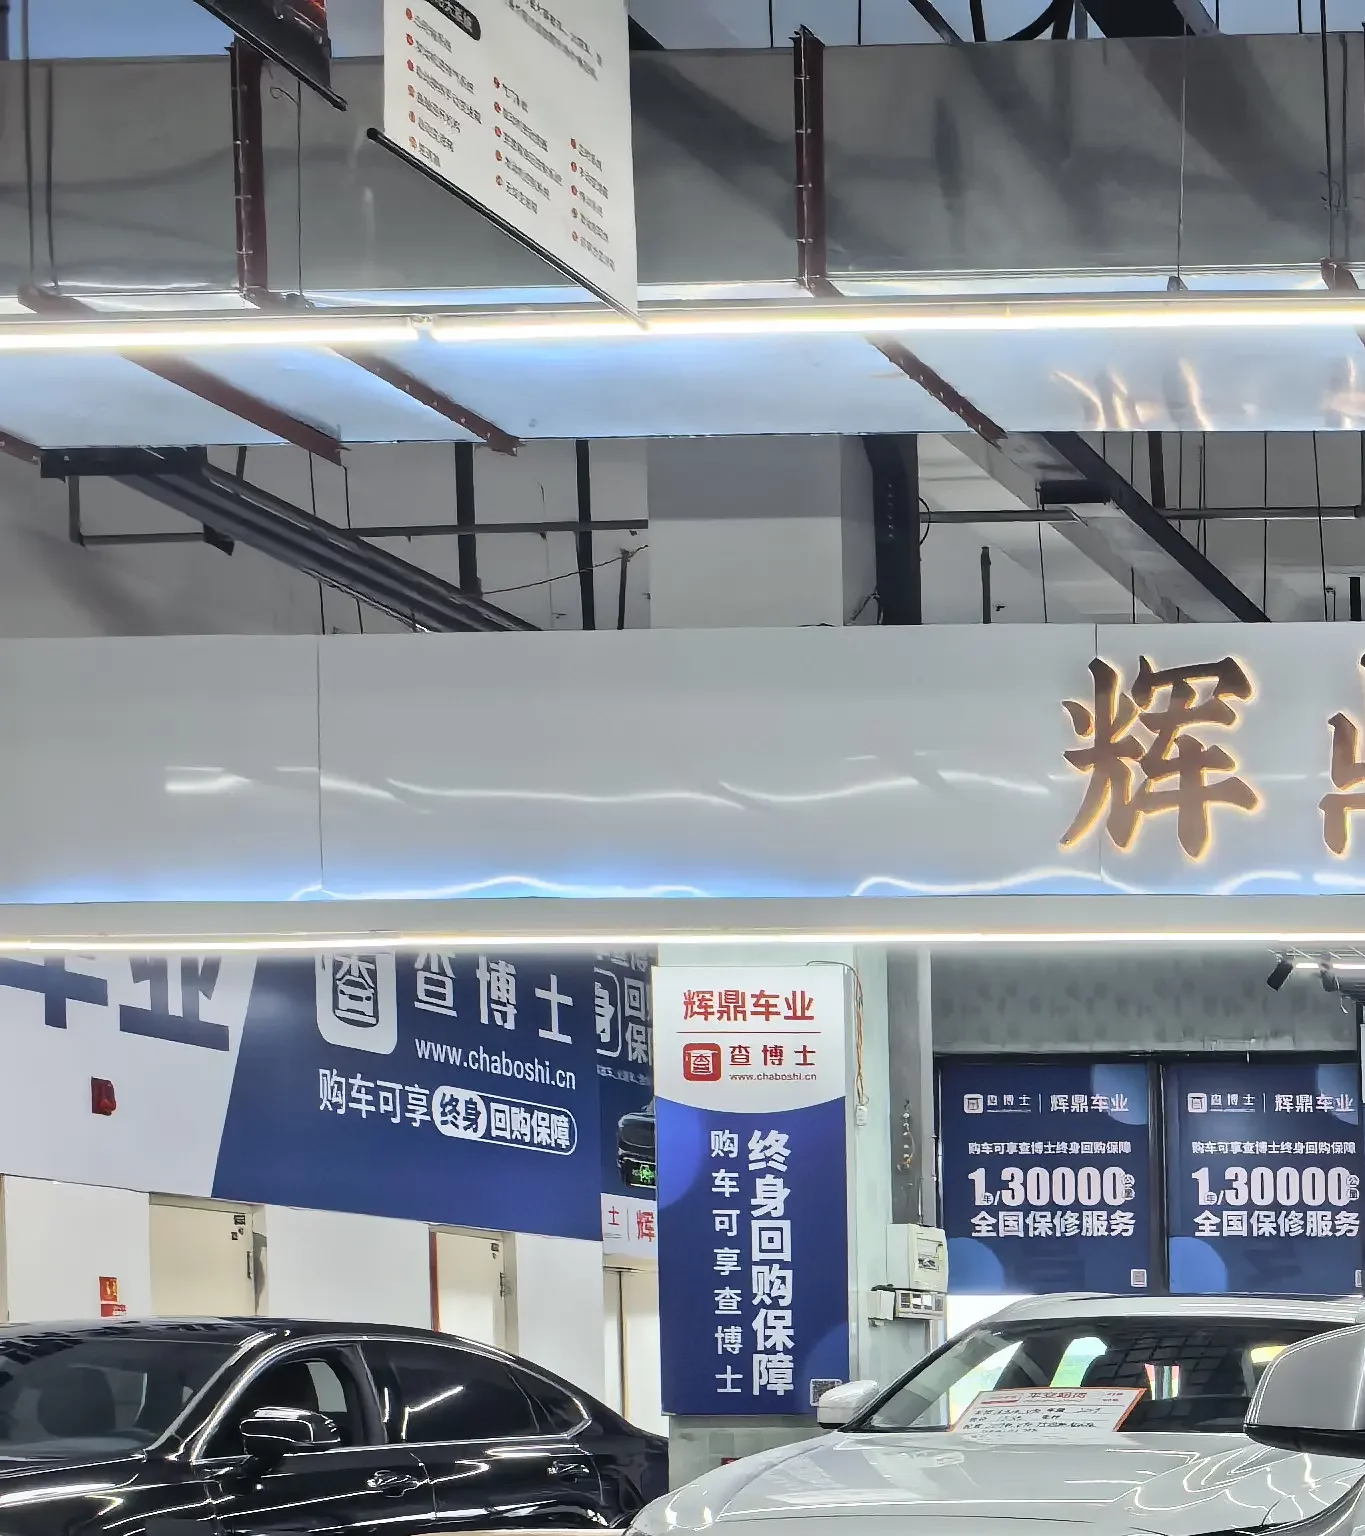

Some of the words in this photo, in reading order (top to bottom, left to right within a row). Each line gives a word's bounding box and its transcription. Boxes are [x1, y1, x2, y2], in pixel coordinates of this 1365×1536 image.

[414, 952, 574, 1045] 查博士
[683, 989, 815, 1022] 辉鼎车业
[415, 1038, 577, 1090] www.chaboshi.cn
[729, 1044, 817, 1066] 查博士
[729, 1072, 818, 1082] www.chaboshi.cn
[1050, 1093, 1130, 1113] 辉鼎车业
[1274, 1092, 1355, 1113] 辉鼎车业
[970, 1210, 1136, 1238] 全国保修服务
[1193, 1210, 1360, 1238] 全国保修服务
[710, 1129, 744, 1393] 购车可享查博士
[748, 1129, 796, 1396] 终身回购保障
